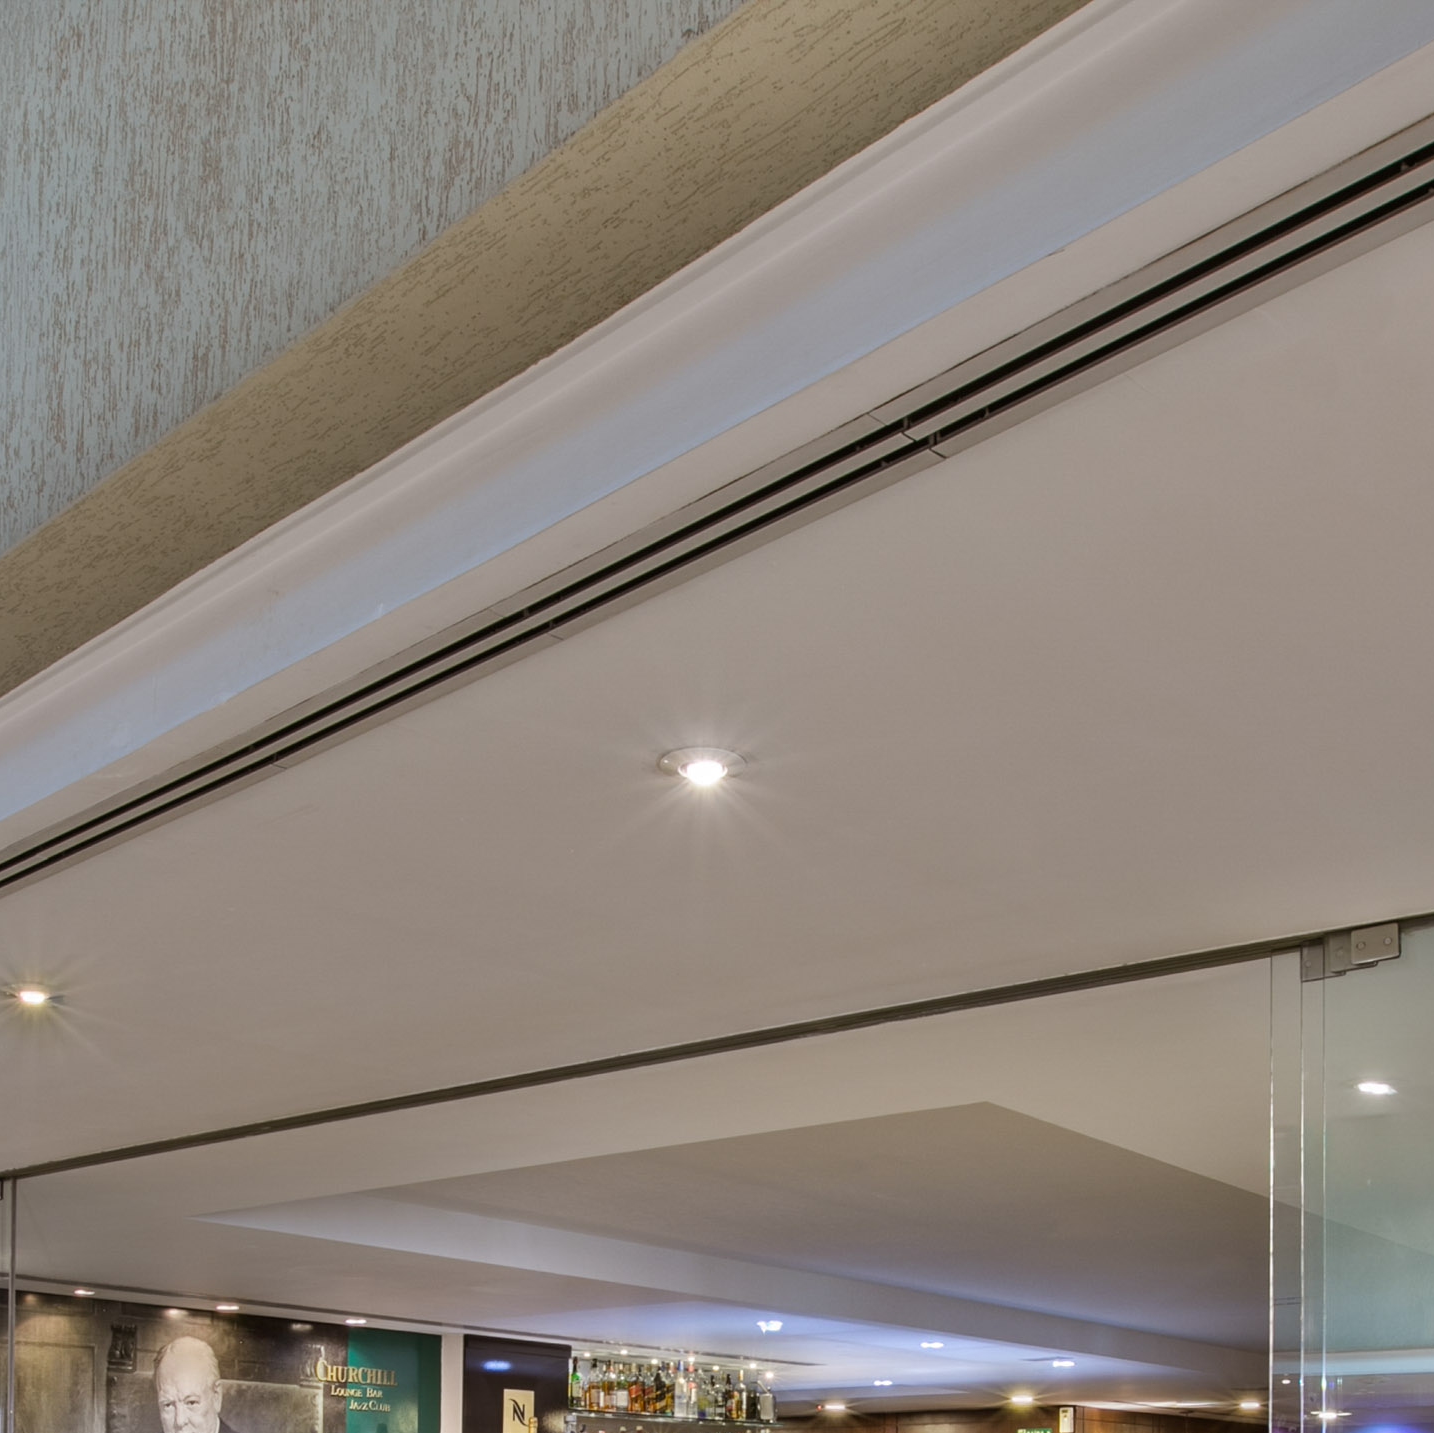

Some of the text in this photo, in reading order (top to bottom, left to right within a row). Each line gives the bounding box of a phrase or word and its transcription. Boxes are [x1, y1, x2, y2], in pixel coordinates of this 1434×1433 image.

[315, 1359, 398, 1386] CHURCHILL
[330, 1384, 383, 1398] LOUNGE BAR
